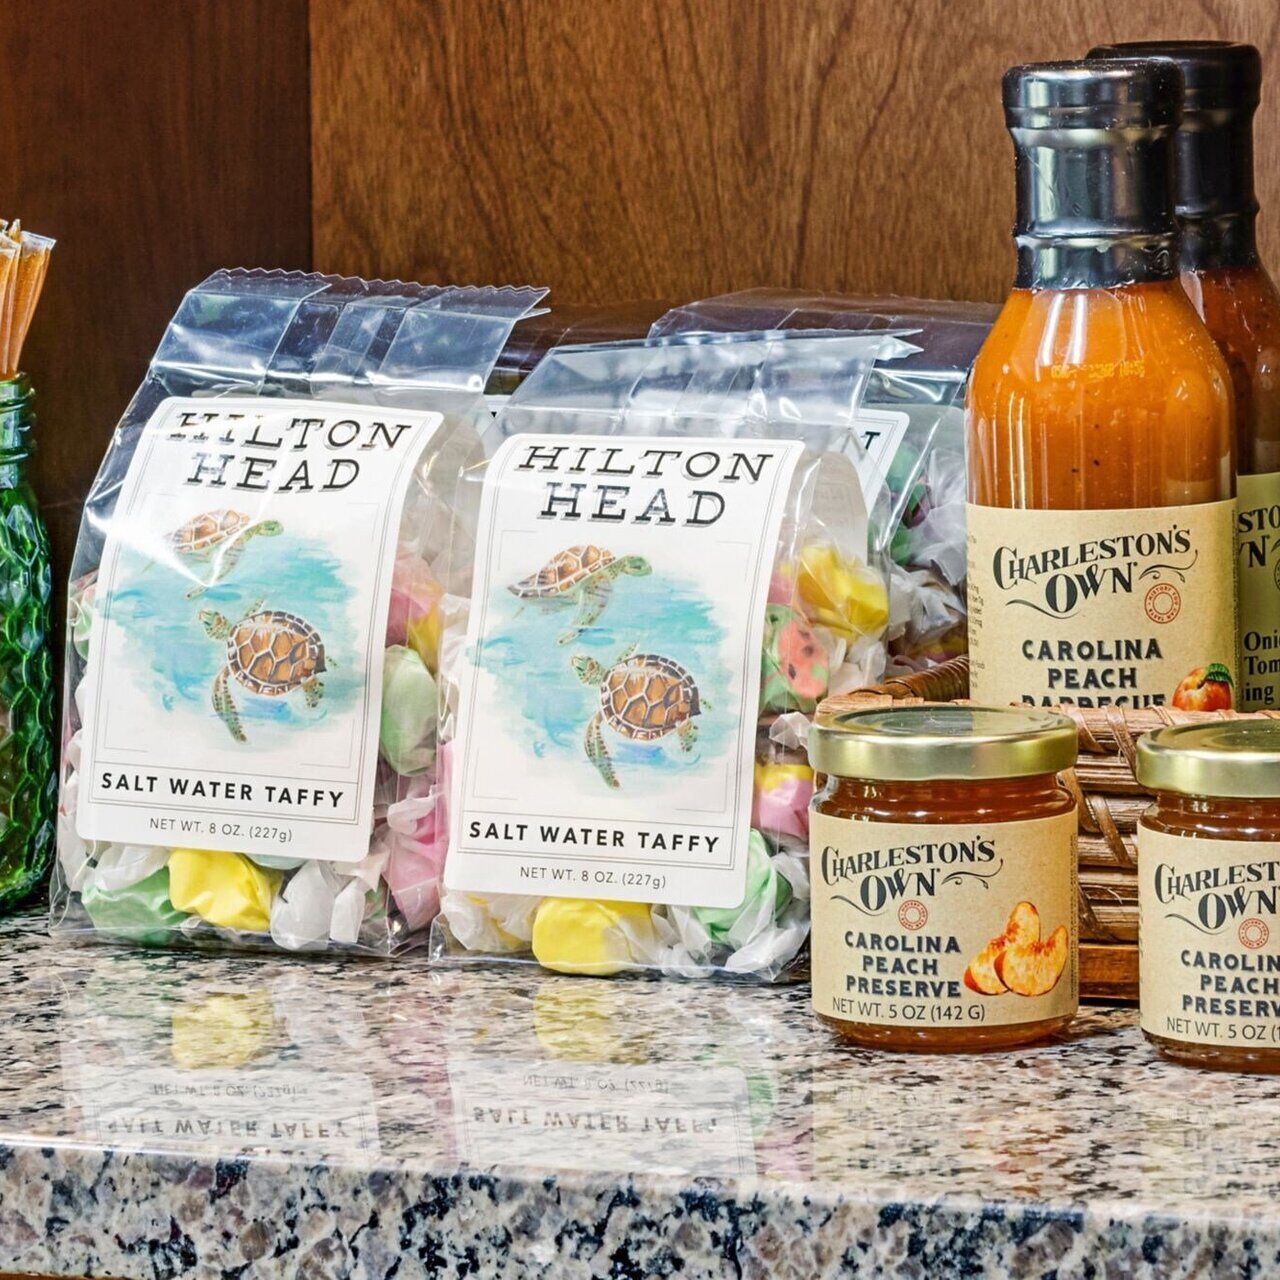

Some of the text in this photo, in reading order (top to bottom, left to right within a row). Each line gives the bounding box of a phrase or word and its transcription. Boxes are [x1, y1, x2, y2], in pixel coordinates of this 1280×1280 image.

[185, 452, 360, 493] HEAD
[518, 444, 772, 483] HILTON
[538, 482, 726, 527] HEAD
[993, 524, 1191, 590] CHARLESTON'S
[1045, 562, 1132, 614] OWN
[1022, 638, 1163, 660] CAROLINA
[1048, 667, 1137, 689] PEACH
[101, 773, 344, 809] SALT WATER TAFFY
[150, 817, 293, 843] NET WT. 8 OZ. (227g)
[469, 820, 719, 854] SALT WATER TAFFY
[822, 835, 995, 886] CHARLESTON'S
[520, 866, 666, 890] NET WT. 8 OZ. (227g)
[860, 869, 936, 911] OWN
[1198, 886, 1276, 930] OWN
[845, 931, 961, 954] CAROLINA
[863, 955, 938, 975] PEACH
[846, 975, 962, 998] PRESERVE
[1200, 974, 1279, 994] PEACH
[833, 996, 985, 1021] NET WT. 5 OZ (142 G)
[1167, 1017, 1190, 1033] NET
[1195, 1022, 1223, 1038] WT.
[1228, 1024, 1236, 1038] 5
[1242, 1024, 1266, 1039] OZ
